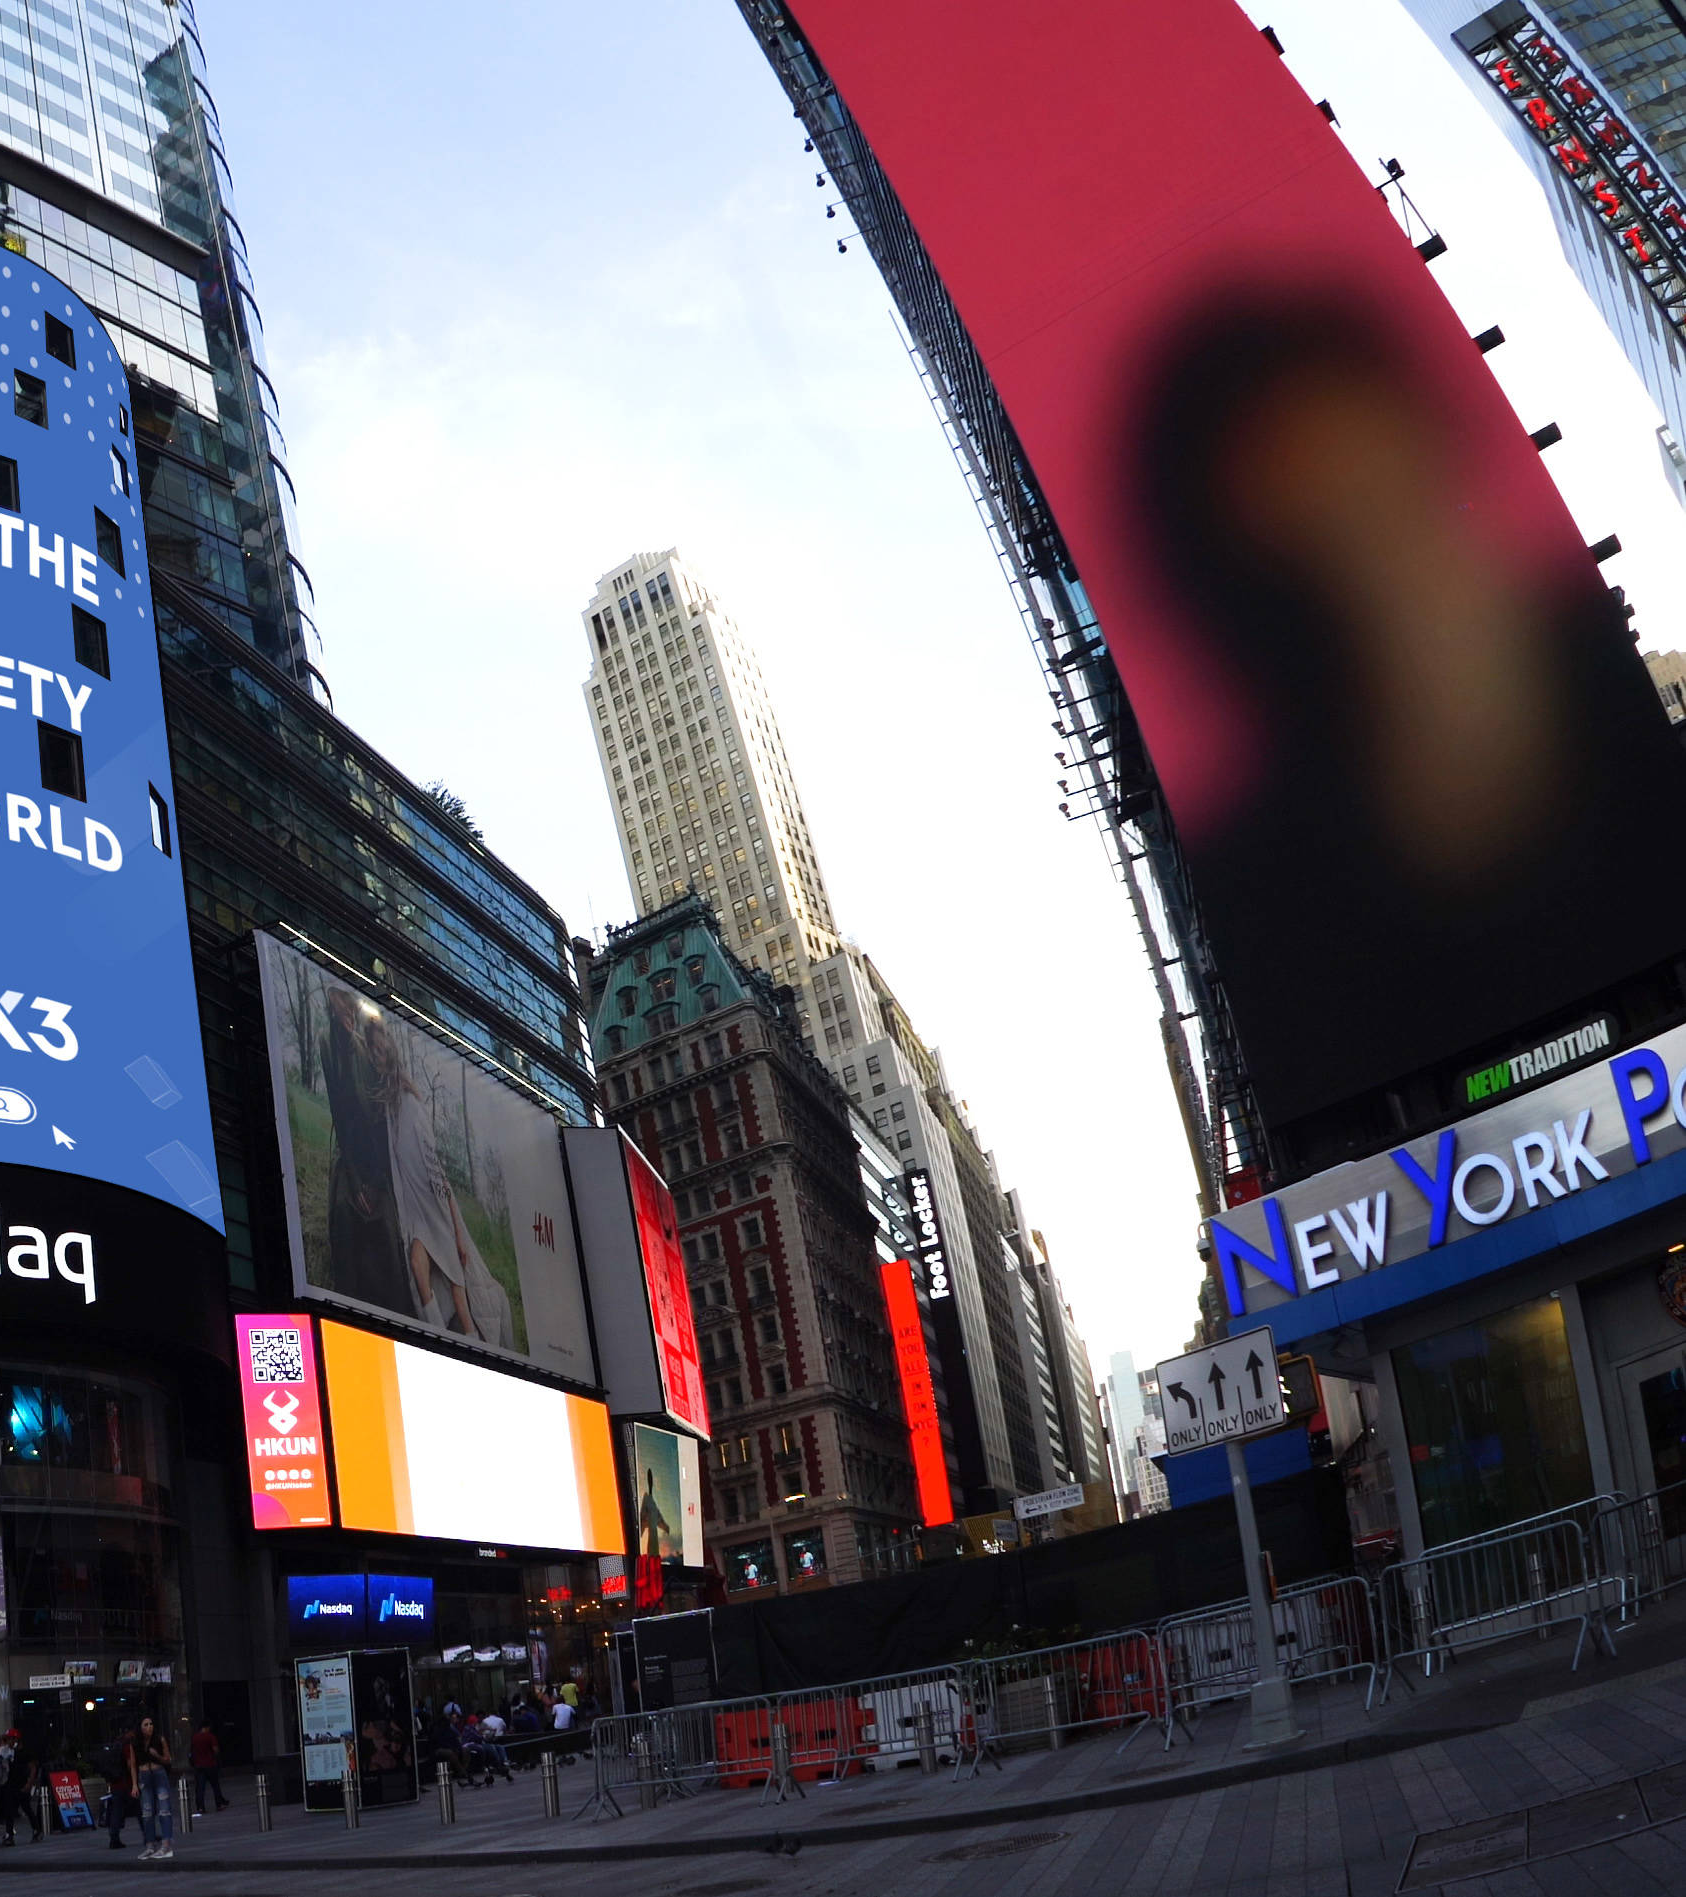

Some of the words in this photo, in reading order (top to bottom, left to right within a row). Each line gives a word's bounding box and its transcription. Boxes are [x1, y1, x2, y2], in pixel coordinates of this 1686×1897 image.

[1494, 58, 1651, 263] ERNST
[1608, 1047, 1686, 1167] P
[911, 1176, 939, 1248] Locker
[924, 1250, 950, 1300] Foot
[254, 1436, 317, 1456] HKUN
[1171, 1426, 1202, 1447] ONLY
[1208, 1414, 1239, 1436] ONLY
[1245, 1403, 1278, 1425] ONLY
[319, 1602, 353, 1616] Nasdaq
[394, 1600, 425, 1620] Nasdaq
